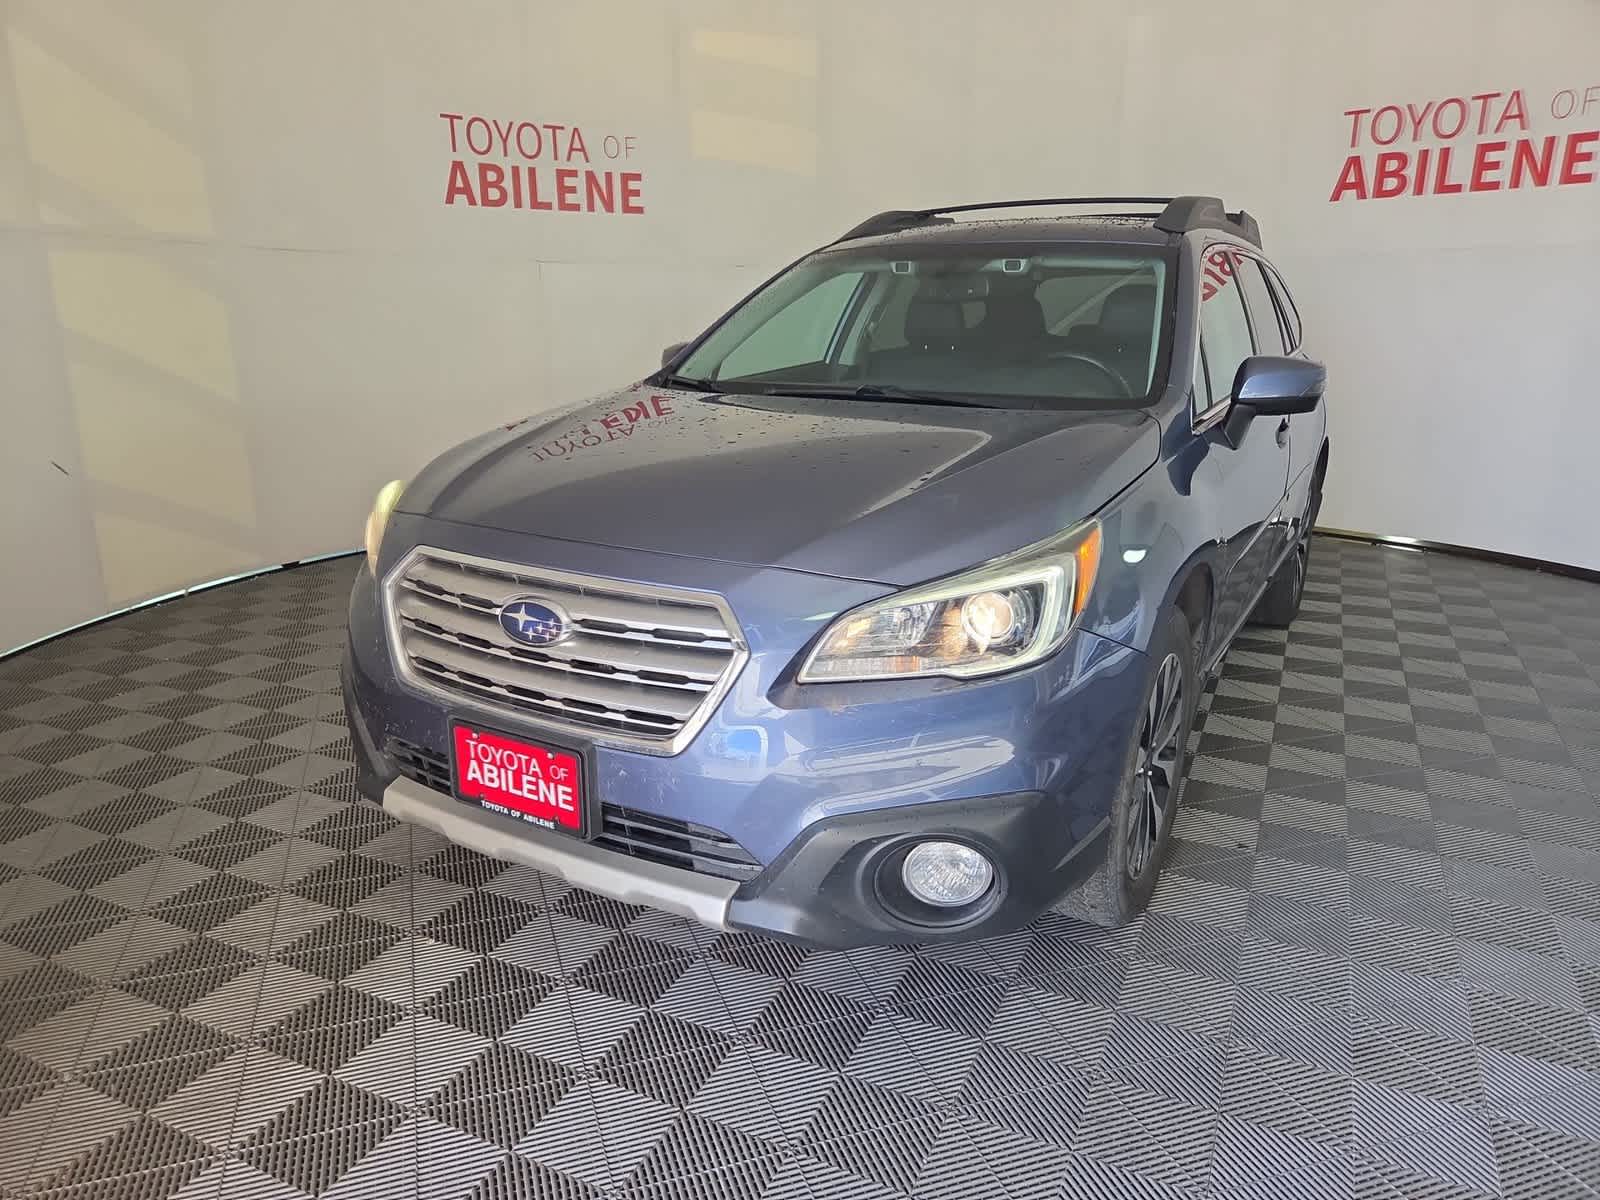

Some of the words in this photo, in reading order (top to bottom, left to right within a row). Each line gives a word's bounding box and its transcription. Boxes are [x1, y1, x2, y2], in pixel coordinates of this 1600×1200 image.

[440, 113, 590, 163] TOYOTA
[603, 135, 637, 160] OF
[1344, 90, 1528, 148] TOYOTA
[1551, 86, 1600, 119] OF
[445, 160, 644, 214] ABILENE
[1329, 131, 1600, 202] ABILENE
[465, 739, 542, 778] TOYOTA
[550, 765, 568, 781] OF
[467, 760, 574, 812] ABILENE
[481, 800, 508, 815] TOYOTA
[511, 809, 521, 818] OF
[523, 814, 555, 829] ABILENE
